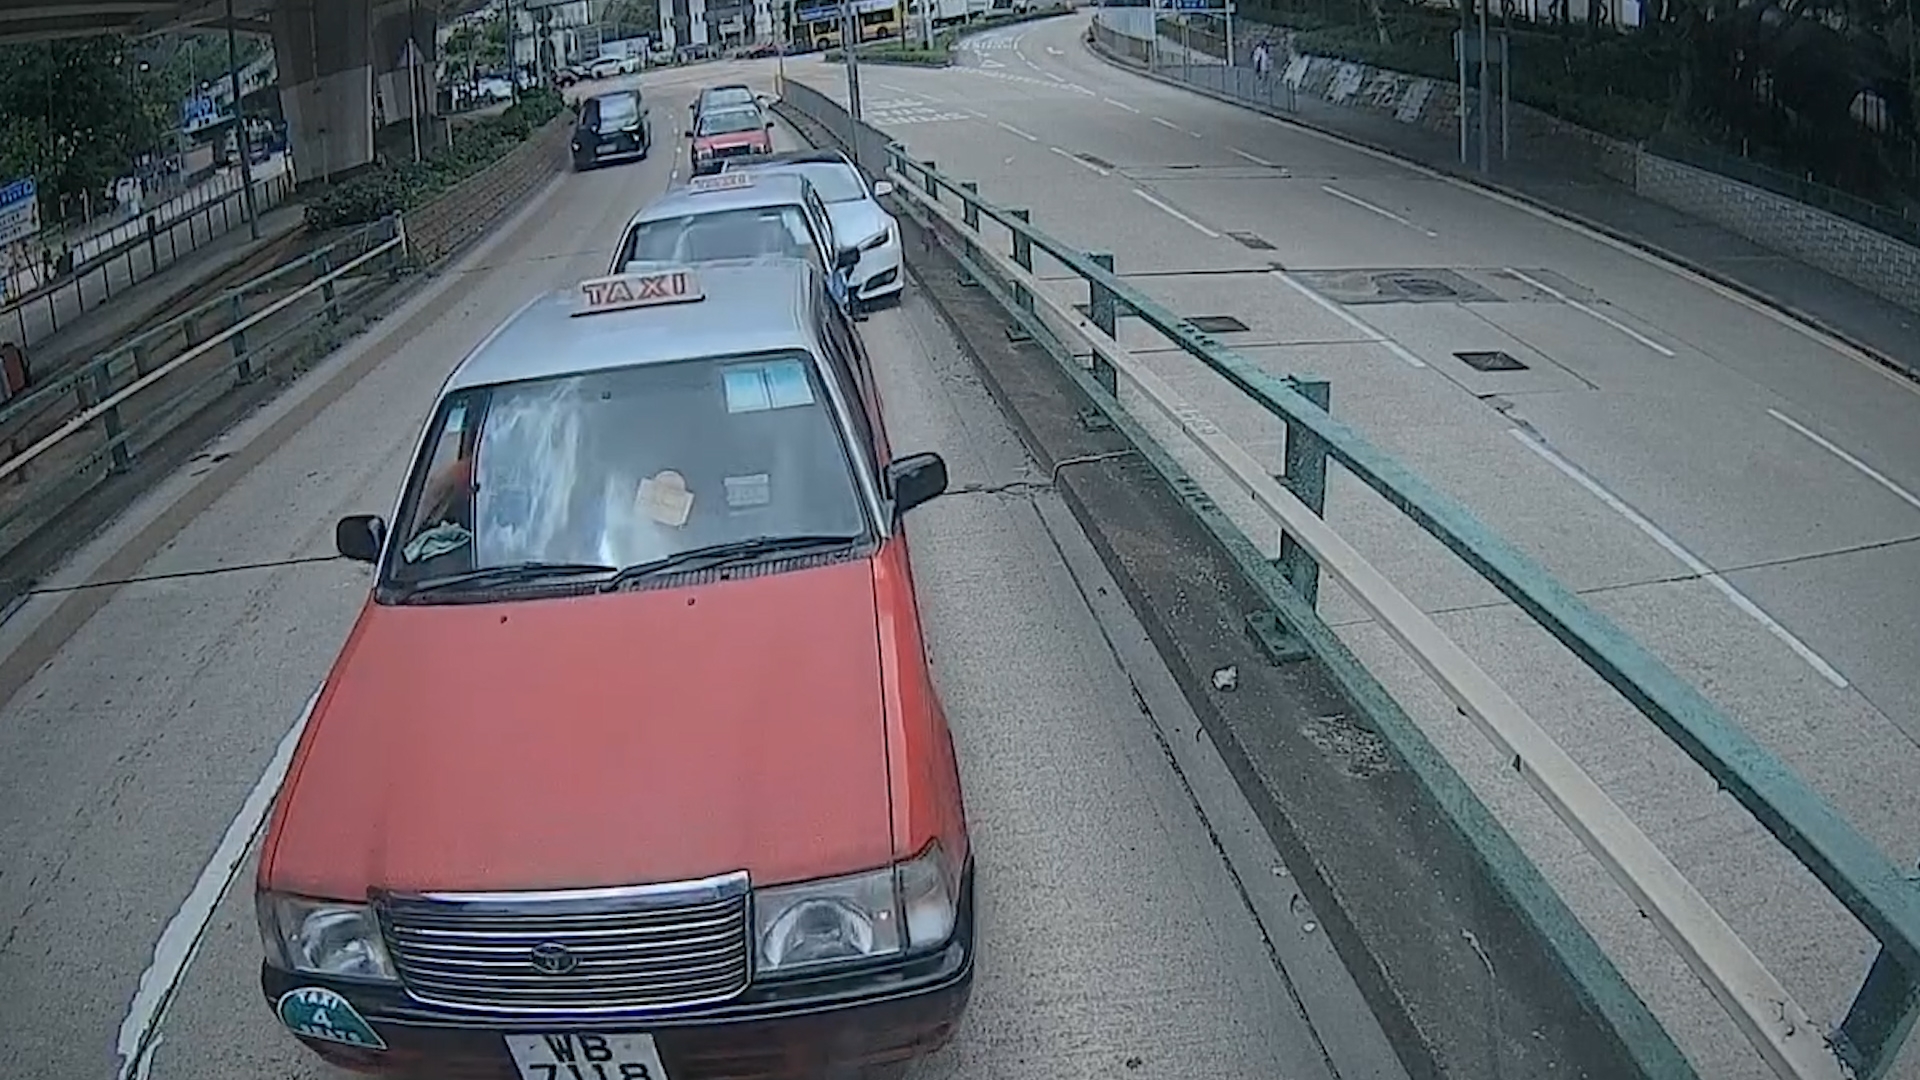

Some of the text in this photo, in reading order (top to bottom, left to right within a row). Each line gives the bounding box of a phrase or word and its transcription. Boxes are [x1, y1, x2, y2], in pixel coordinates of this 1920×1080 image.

[582, 272, 687, 306] TAXI
[297, 992, 340, 1010] TAXI
[312, 1007, 333, 1029] 4
[543, 1034, 613, 1063] WB
[529, 1062, 653, 1080] 7118
